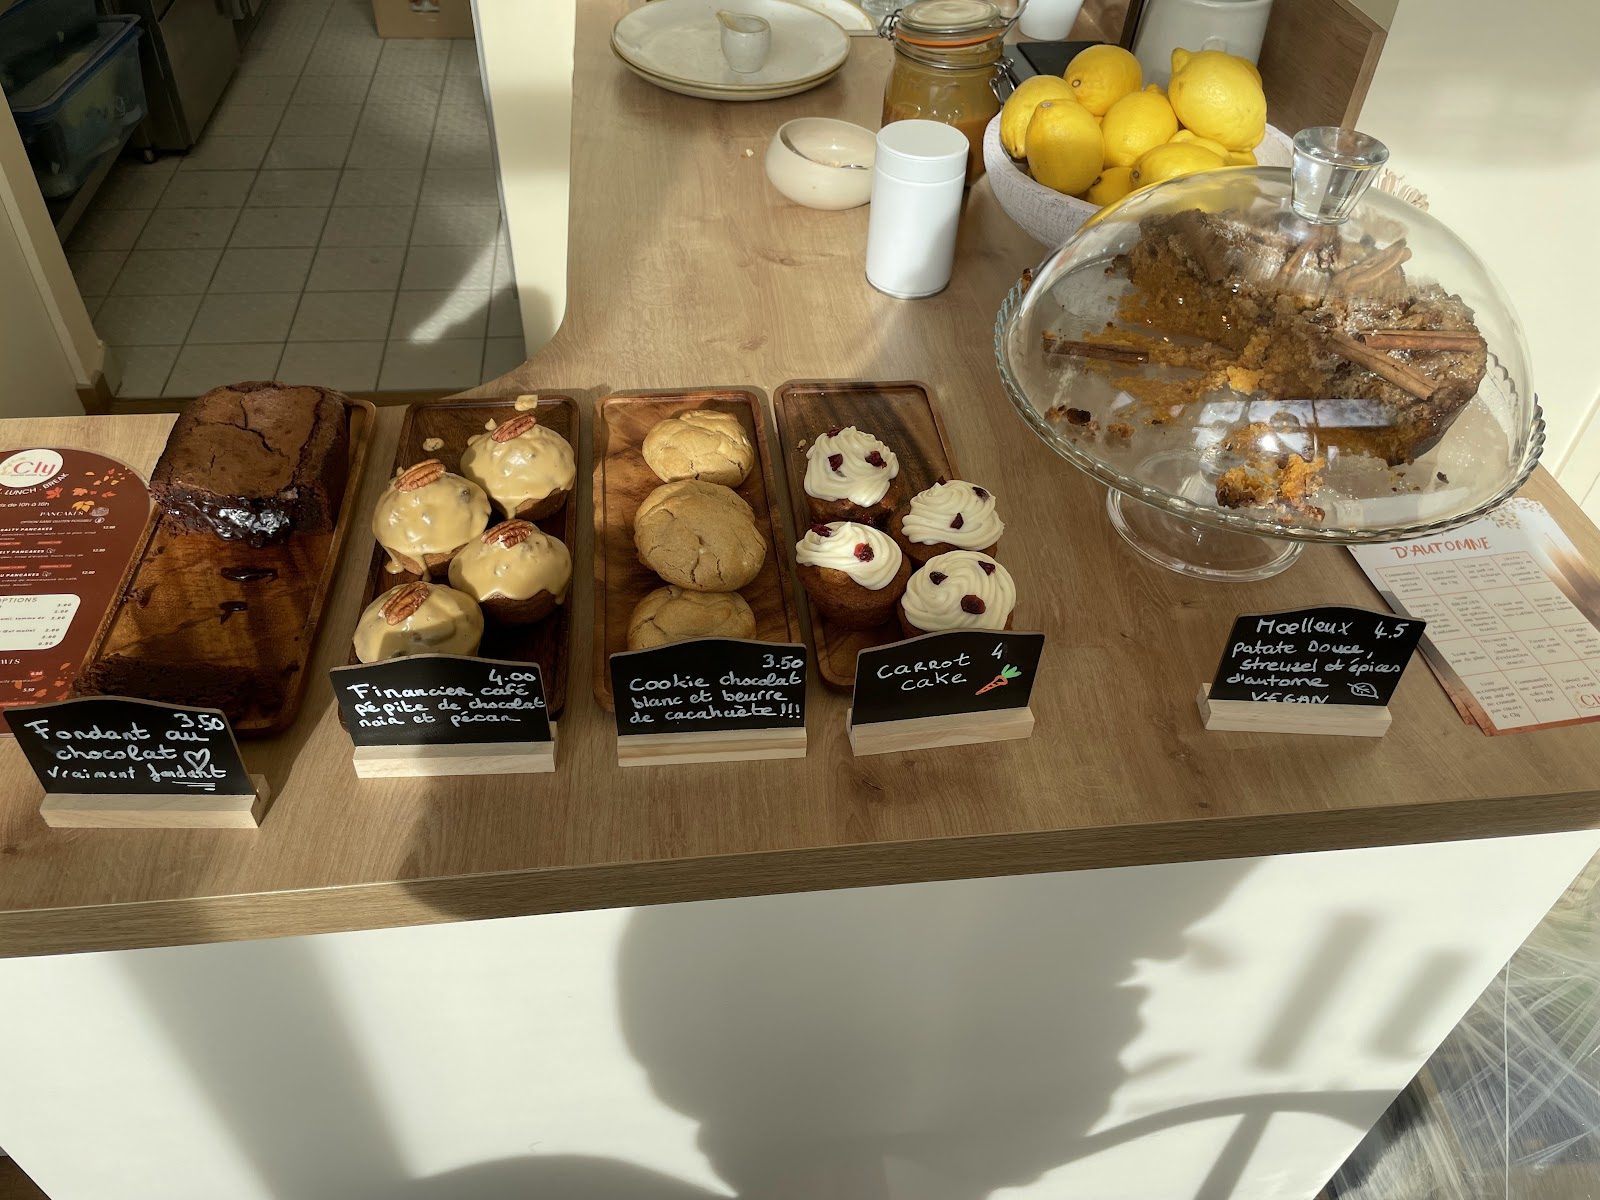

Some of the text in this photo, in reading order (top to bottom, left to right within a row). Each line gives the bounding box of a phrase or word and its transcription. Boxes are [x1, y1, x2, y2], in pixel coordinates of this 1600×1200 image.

[13, 461, 56, 476] Cly
[4, 488, 37, 496] LUNCH
[1390, 536, 1492, 559] D'AUTOMNE
[1374, 621, 1409, 639] 4.5
[991, 642, 1003, 660] 4
[1231, 639, 1298, 658] patate
[762, 653, 804, 670] 3.50
[1324, 658, 1346, 672] et
[1348, 657, 1401, 676] épices
[488, 668, 536, 686] 4.00
[629, 670, 802, 692] Cookie chocolat
[480, 683, 529, 696] café
[1251, 691, 1330, 704] VEGAN
[437, 698, 462, 711] de
[468, 696, 546, 710] chocolat
[631, 689, 788, 709] blanc et beurre
[173, 712, 225, 731] 3.50
[413, 713, 436, 724] et
[450, 711, 521, 728] pécan
[629, 711, 655, 724] de
[24, 719, 210, 742] Fondant au
[56, 744, 177, 761] chocolat
[146, 763, 227, 783] fondant
